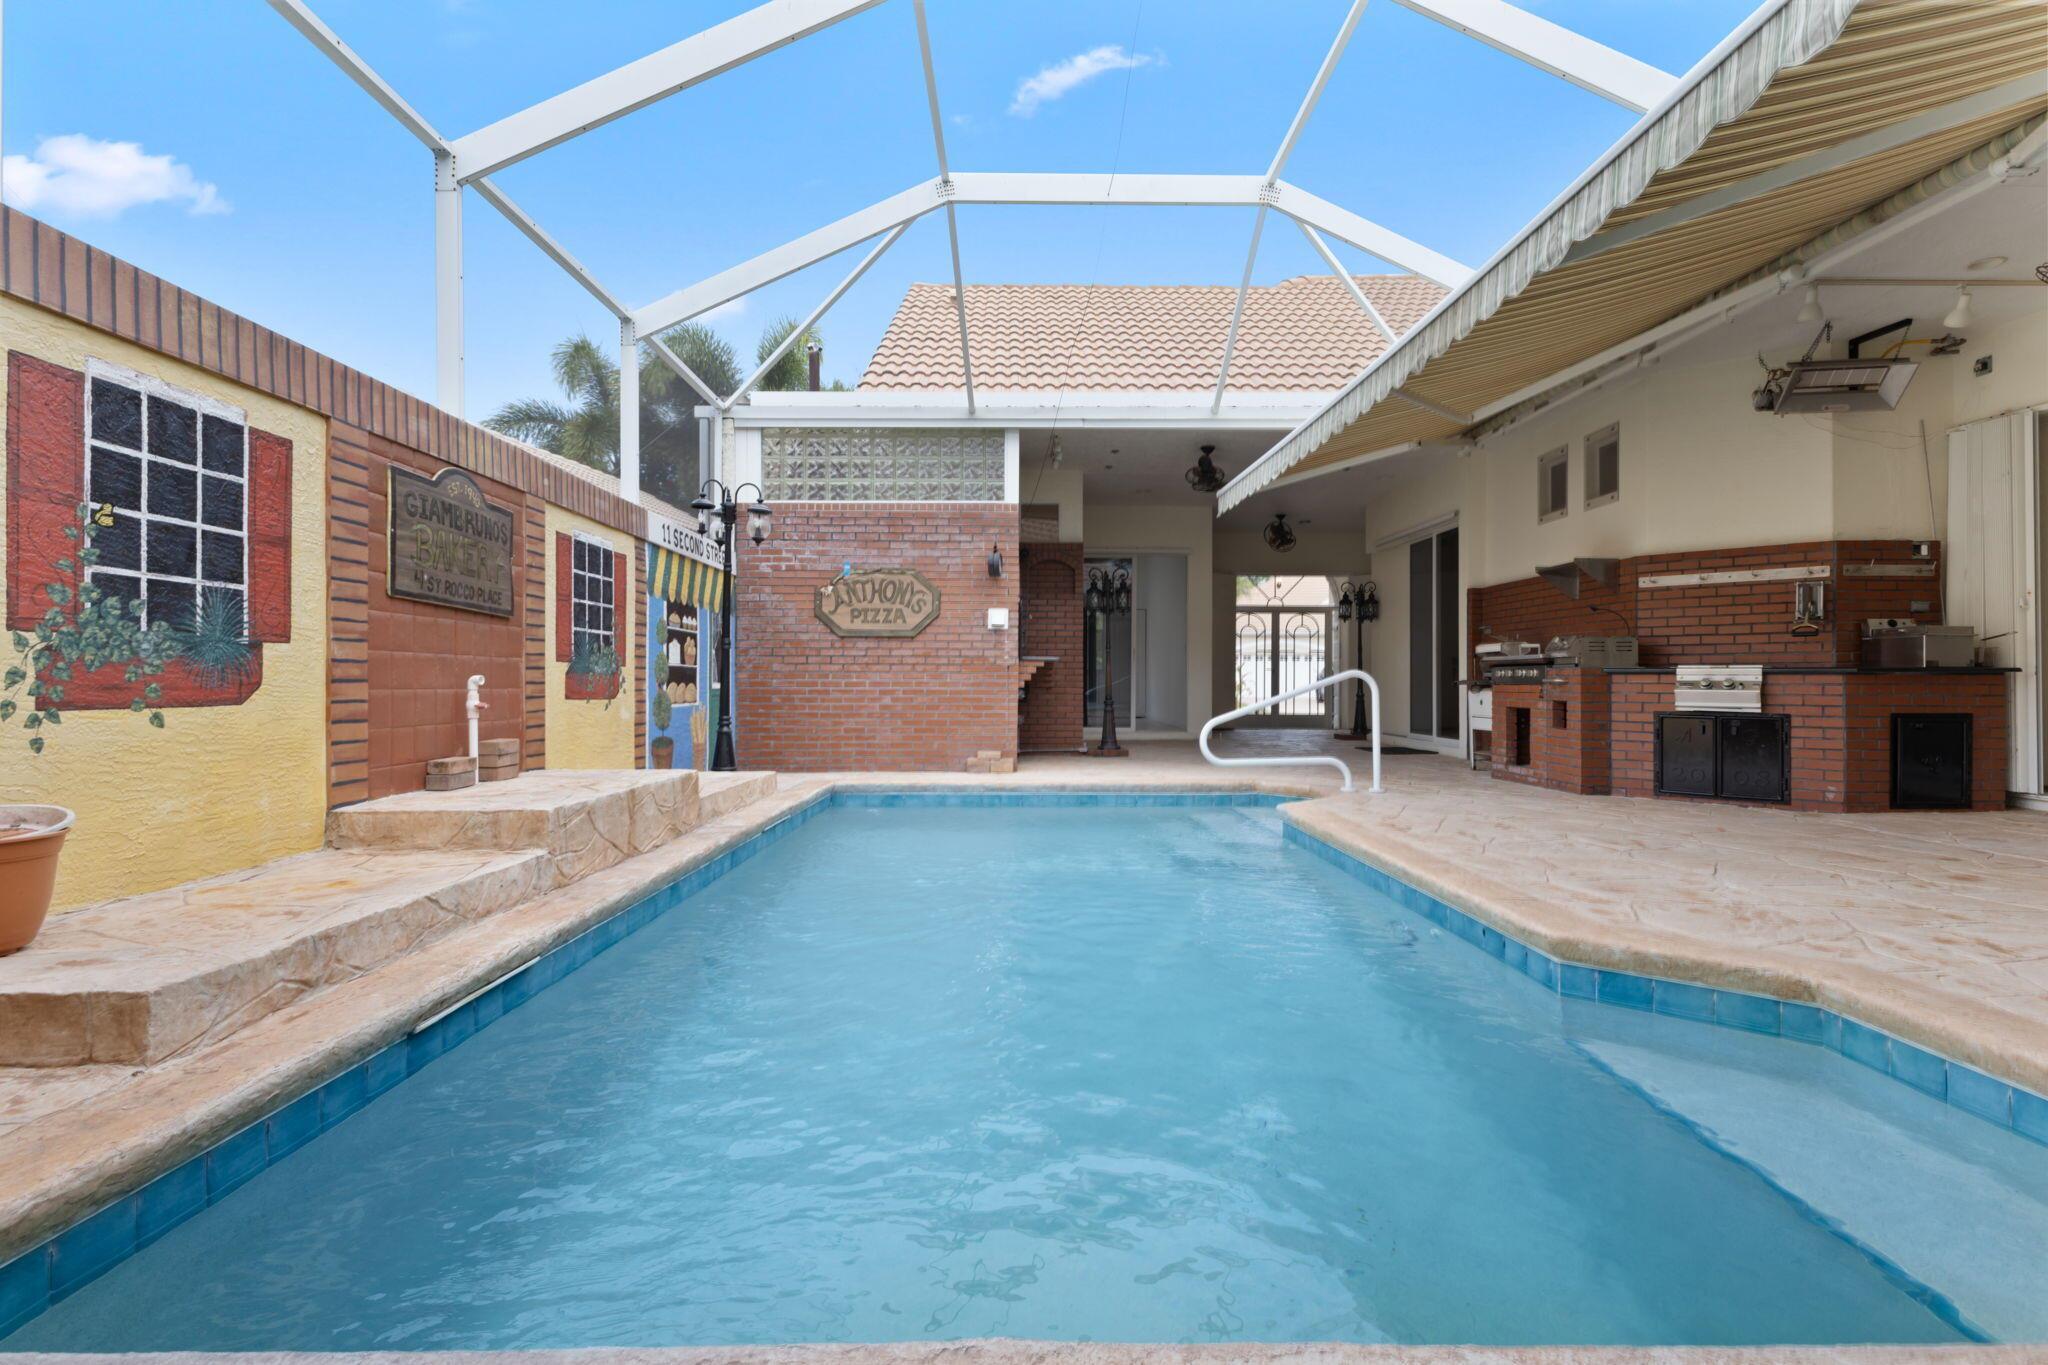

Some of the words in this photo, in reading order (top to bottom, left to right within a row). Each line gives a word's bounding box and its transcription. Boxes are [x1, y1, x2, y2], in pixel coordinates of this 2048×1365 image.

[661, 523, 672, 545] 11
[673, 528, 704, 557] SECOND
[706, 542, 726, 565] STREE
[445, 580, 475, 601] ROCCO
[477, 587, 503, 606] PLACE
[850, 608, 907, 624] PIZZA
